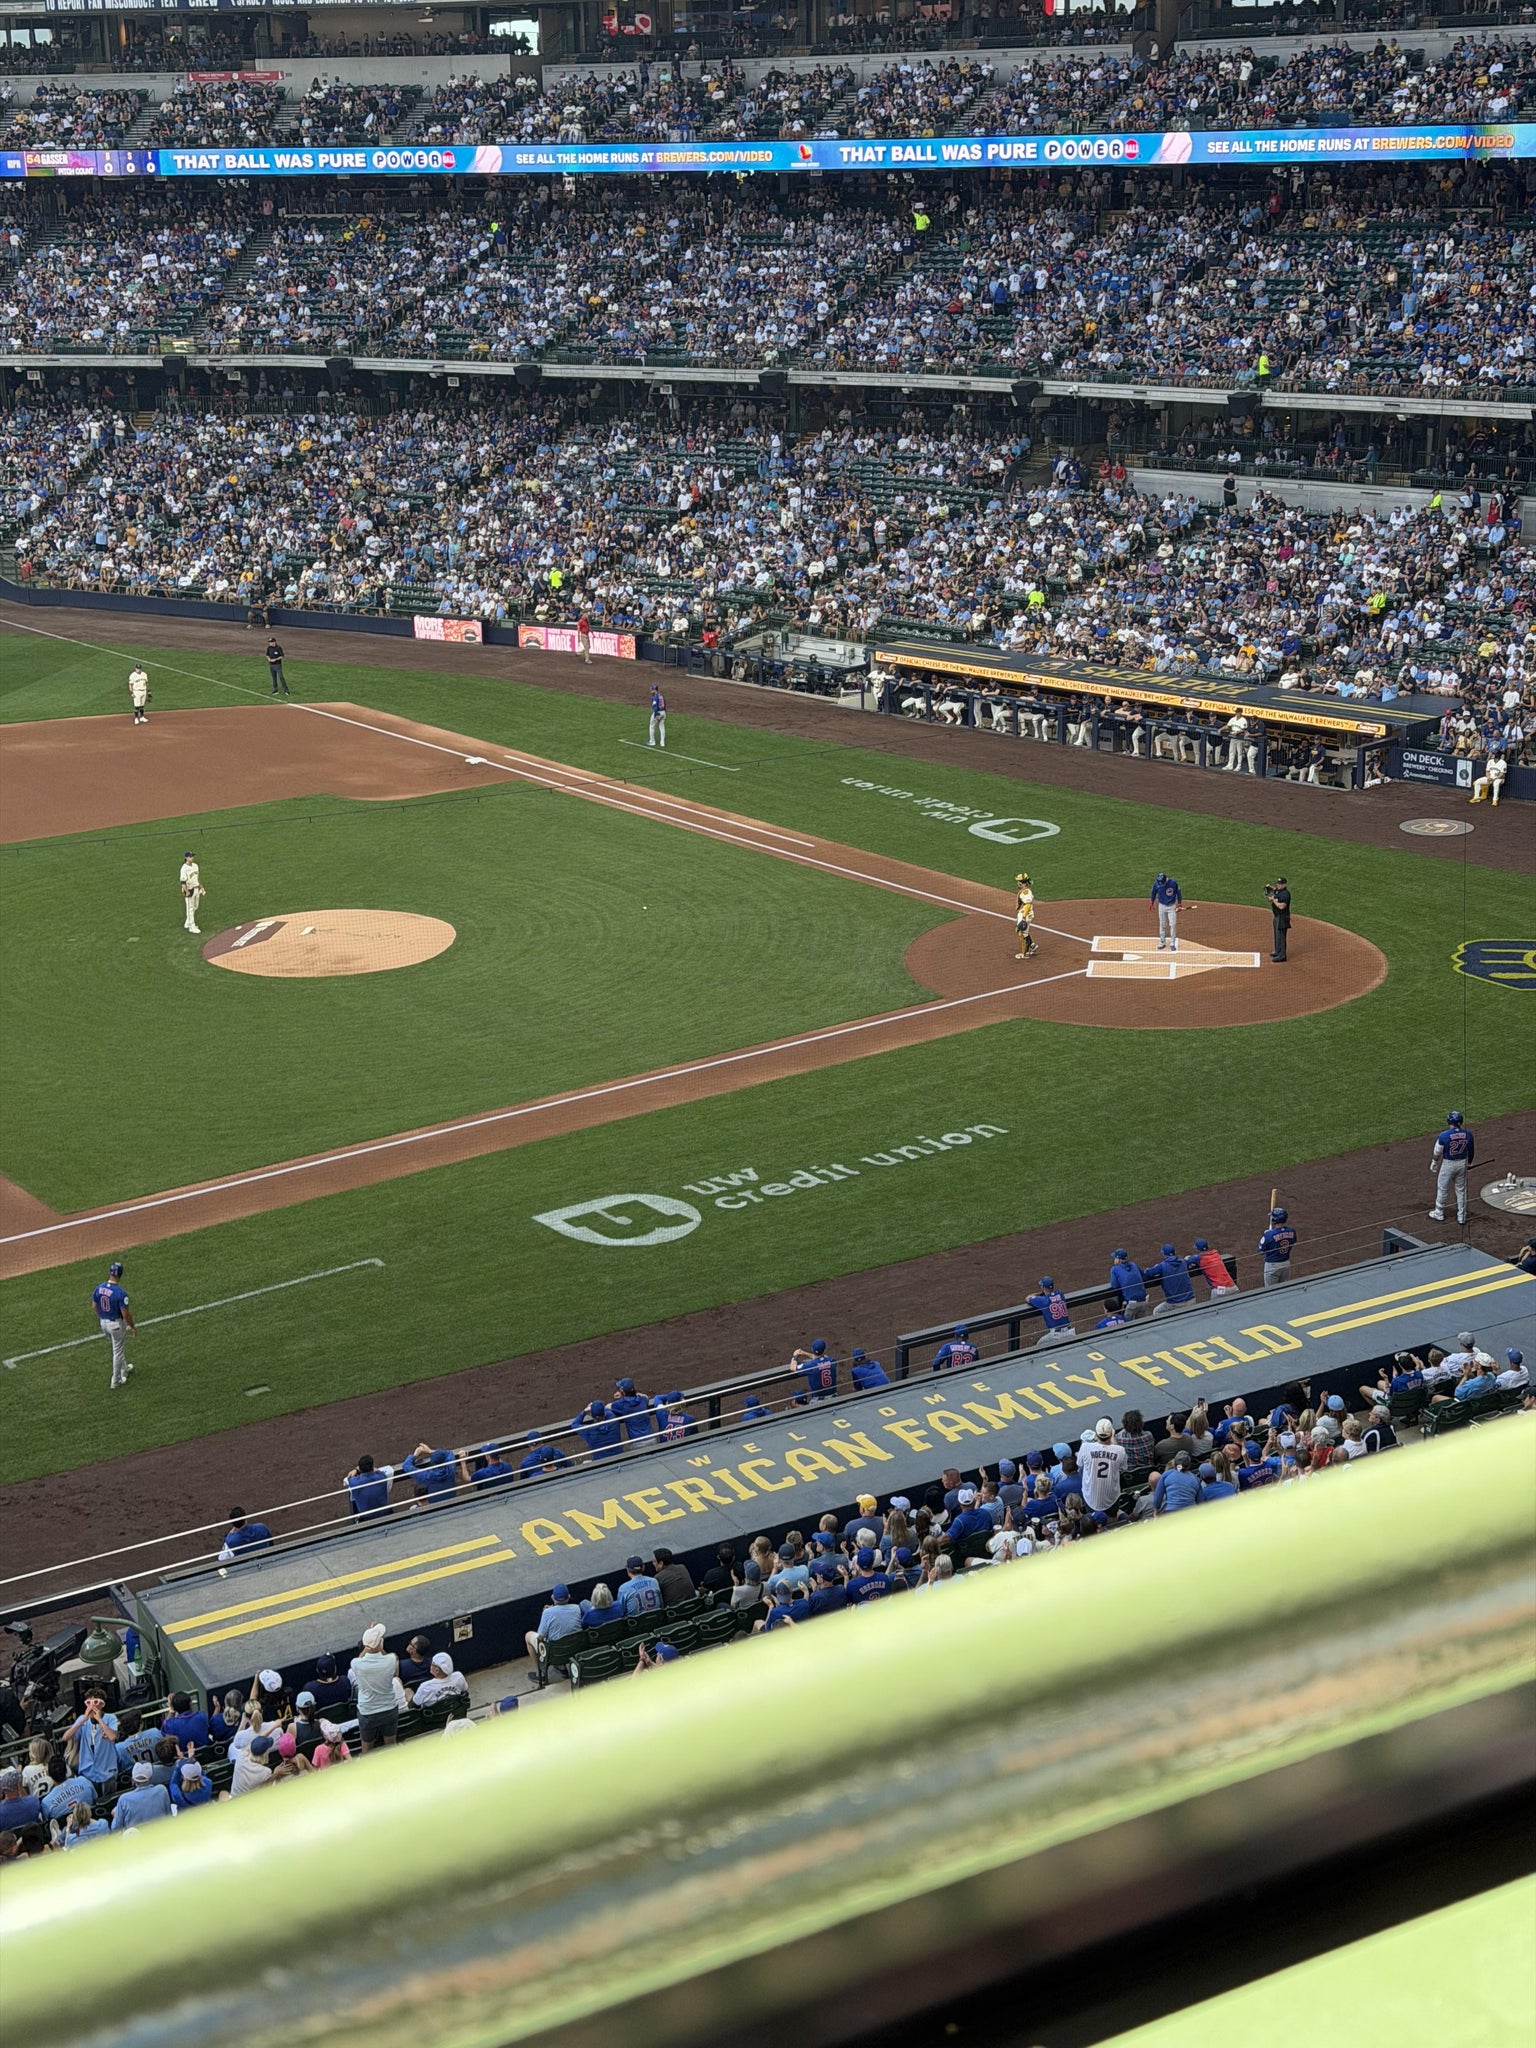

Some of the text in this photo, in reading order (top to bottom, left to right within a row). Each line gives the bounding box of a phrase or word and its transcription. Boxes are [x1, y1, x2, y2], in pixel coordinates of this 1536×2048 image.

[839, 146, 887, 162] THAT
[891, 145, 937, 161] BALL
[941, 144, 982, 160] WAS
[987, 143, 1037, 160] PURE
[1207, 135, 1515, 154] SEE ALL THE HOME RUNS AT BREWERS.COM/VIDEO
[26, 154, 69, 165] 54 GASSER
[173, 155, 220, 169] THAT
[225, 154, 270, 169] BALL
[274, 153, 314, 168] WAS
[318, 153, 367, 168] PURE
[516, 150, 773, 165] SEE ALL THE HOME RUNS AT BREWERS.COM/VIDEO
[104, 163, 113, 173] 0
[126, 163, 136, 173] 0
[146, 163, 155, 173] 0
[414, 616, 444, 630] MORE
[548, 635, 572, 652] MORE
[1204, 701, 1231, 712] OFFICIAL
[1231, 704, 1255, 715] CESE
[1264, 709, 1277, 718] THE
[1277, 711, 1315, 724] MILWAUKEE
[1403, 752, 1445, 766] ON DECK:
[1428, 766, 1453, 775] CHECKING
[840, 777, 994, 818] credit union
[1449, 1140, 1468, 1156] 27
[714, 1121, 1009, 1209] credit union
[682, 1166, 760, 1196] uw
[100, 1295, 111, 1312] 0
[821, 1369, 833, 1388] 6
[519, 1322, 1304, 1557] AMERICAN FAMILY FIELD
[1097, 1462, 1109, 1479] 2
[635, 1589, 657, 1612] 19
[51, 1784, 85, 1808] SWANSON
